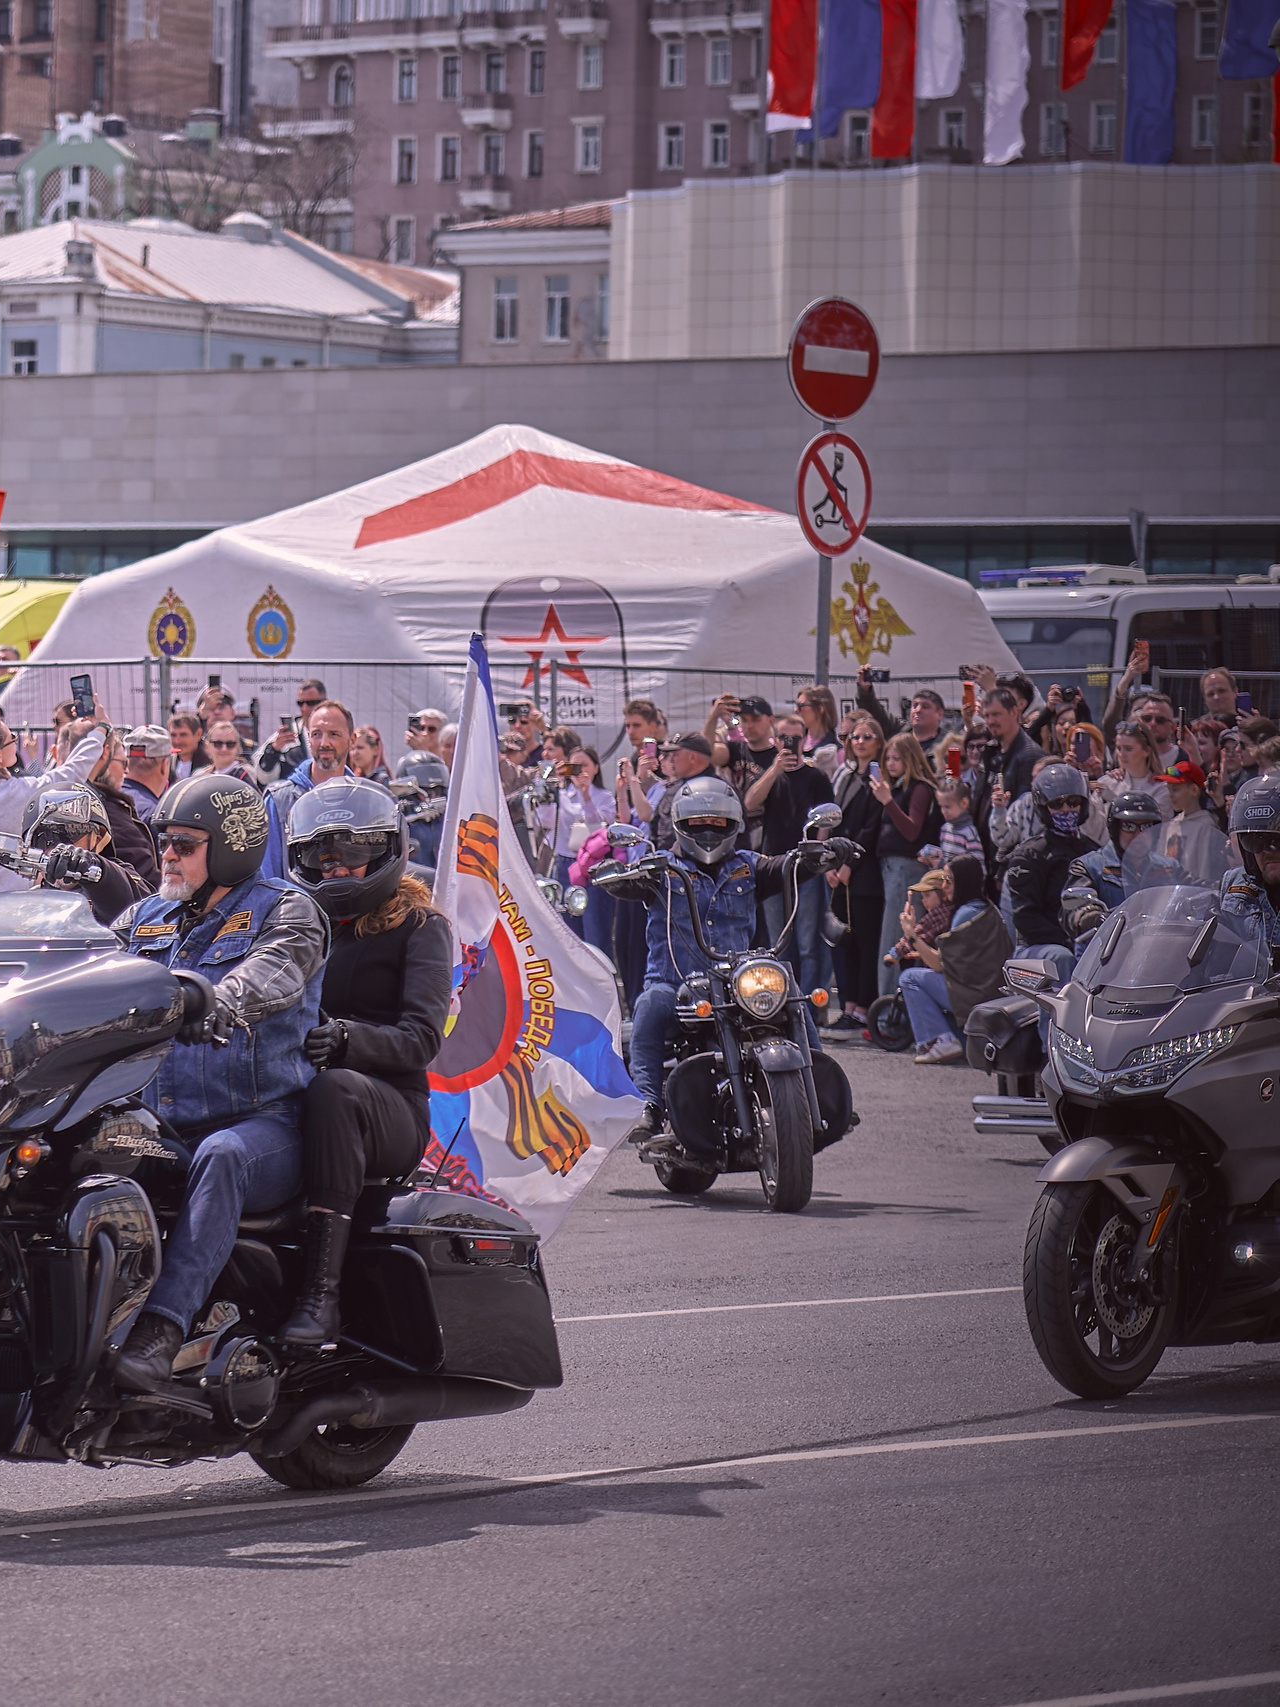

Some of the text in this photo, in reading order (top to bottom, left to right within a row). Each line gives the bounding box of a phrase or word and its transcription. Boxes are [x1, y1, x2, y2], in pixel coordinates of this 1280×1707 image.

[320, 812, 349, 822] HJC
[1247, 807, 1271, 817] SHOEI
[499, 883, 533, 943] ТАМ
[519, 958, 555, 1073] ПОБЕДА!
[131, 1146, 179, 1160] Davidson
